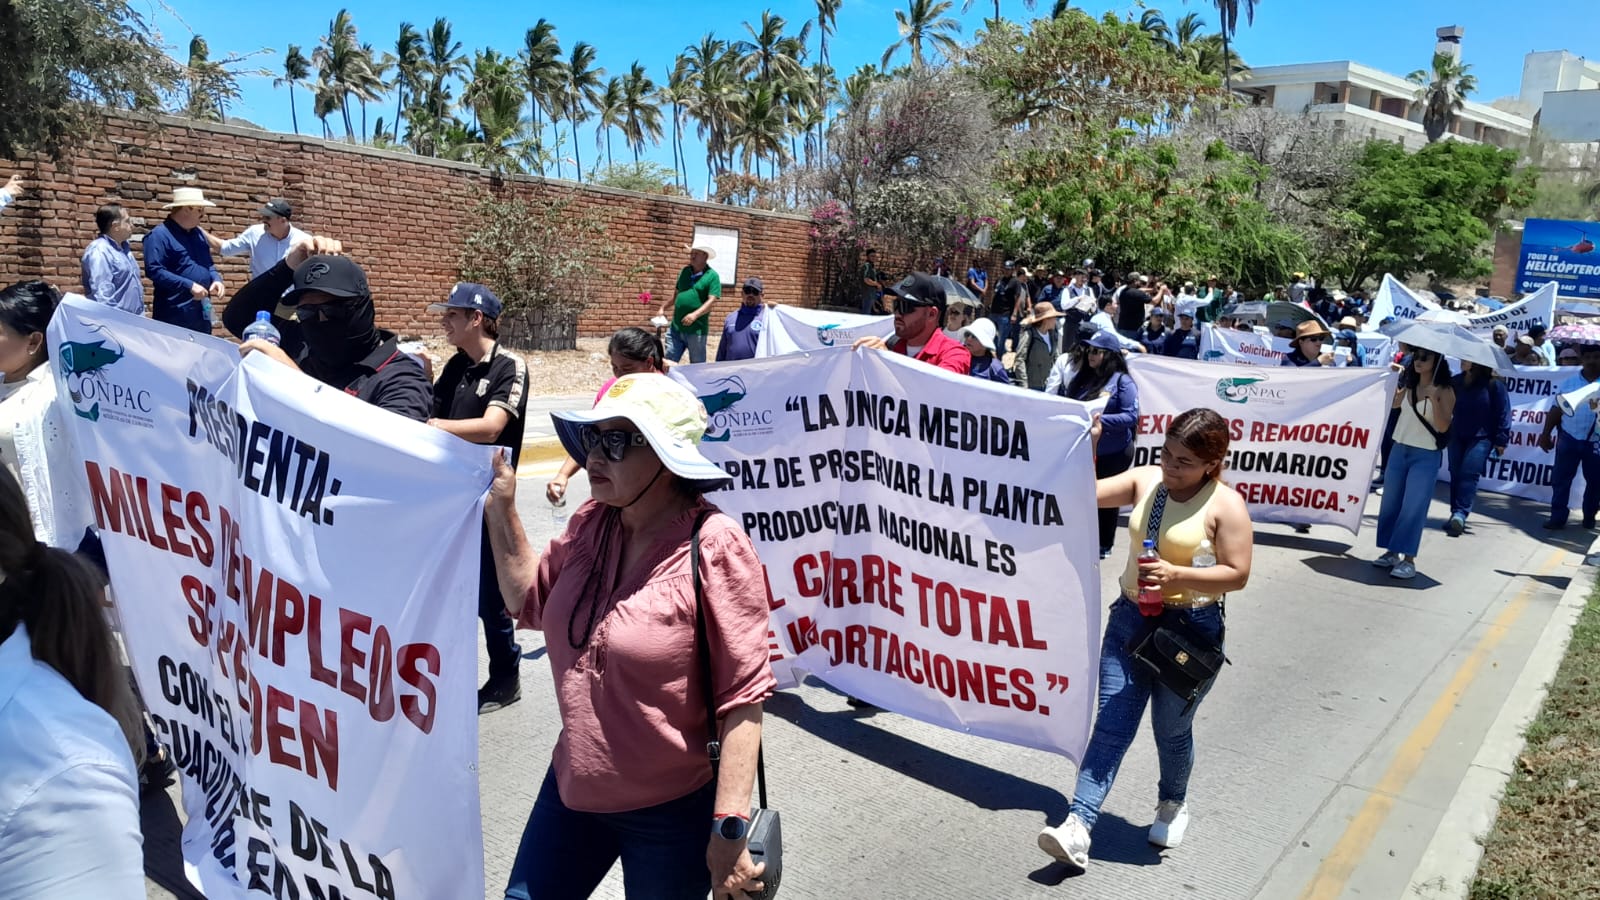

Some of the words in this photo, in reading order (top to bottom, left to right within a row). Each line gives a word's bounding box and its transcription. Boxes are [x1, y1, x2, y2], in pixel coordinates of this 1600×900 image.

[1226, 384, 1287, 400] CONPAC
[1504, 377, 1558, 397] DENTA:
[919, 403, 1030, 462] MEDIDA
[1250, 421, 1371, 449] REMOCIÓN
[1519, 410, 1550, 425] PROT
[1224, 449, 1349, 481] CIONARIOS
[1480, 458, 1555, 487] TENDID
[774, 456, 805, 488] DE
[809, 449, 922, 498] PRSERVAR
[928, 467, 955, 507] LA
[963, 476, 1064, 527] PLANTA
[878, 504, 979, 568] NACIONAL
[984, 539, 1017, 577] ES
[84, 460, 215, 568] MILES
[240, 552, 441, 736] MPLEOS
[792, 550, 905, 617] CIRRE
[911, 571, 1048, 652] TOTAL
[340, 838, 395, 900] LA
